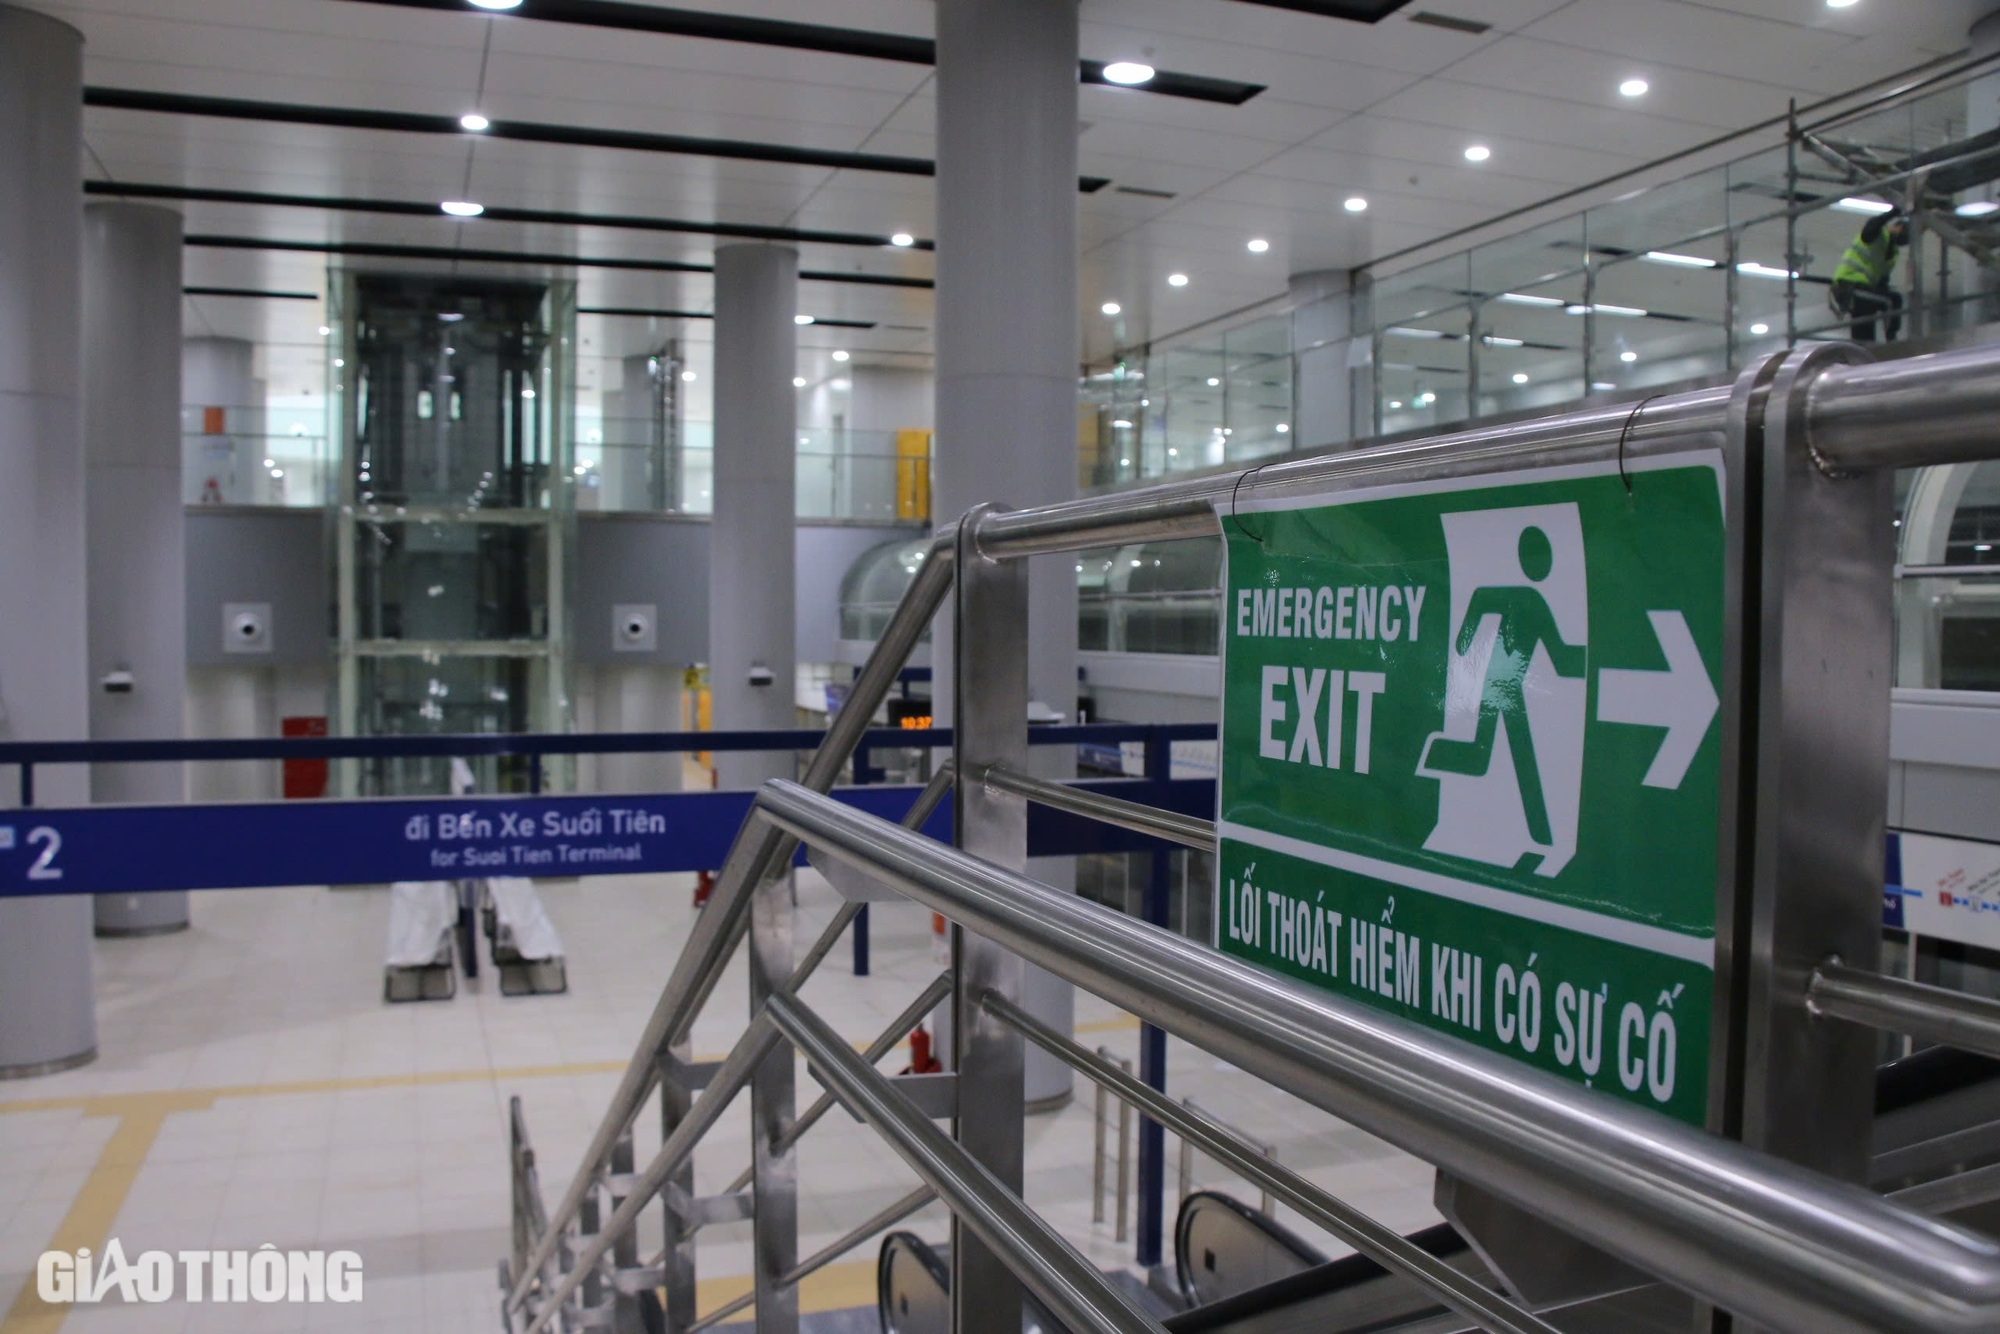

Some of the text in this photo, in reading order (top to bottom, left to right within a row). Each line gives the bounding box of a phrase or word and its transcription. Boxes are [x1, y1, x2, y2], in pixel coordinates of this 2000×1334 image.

[1237, 585, 1427, 642] EMERGENCY
[1259, 665, 1386, 774] EXIT
[405, 808, 666, 840] đi Bến Xe Suối Tiên
[26, 825, 63, 880] 2
[431, 843, 642, 868] for Suoi Tien Terminal
[1229, 862, 1685, 1103] LỐI THOÁT HIỂM KHI CÓ SỰ CỐ
